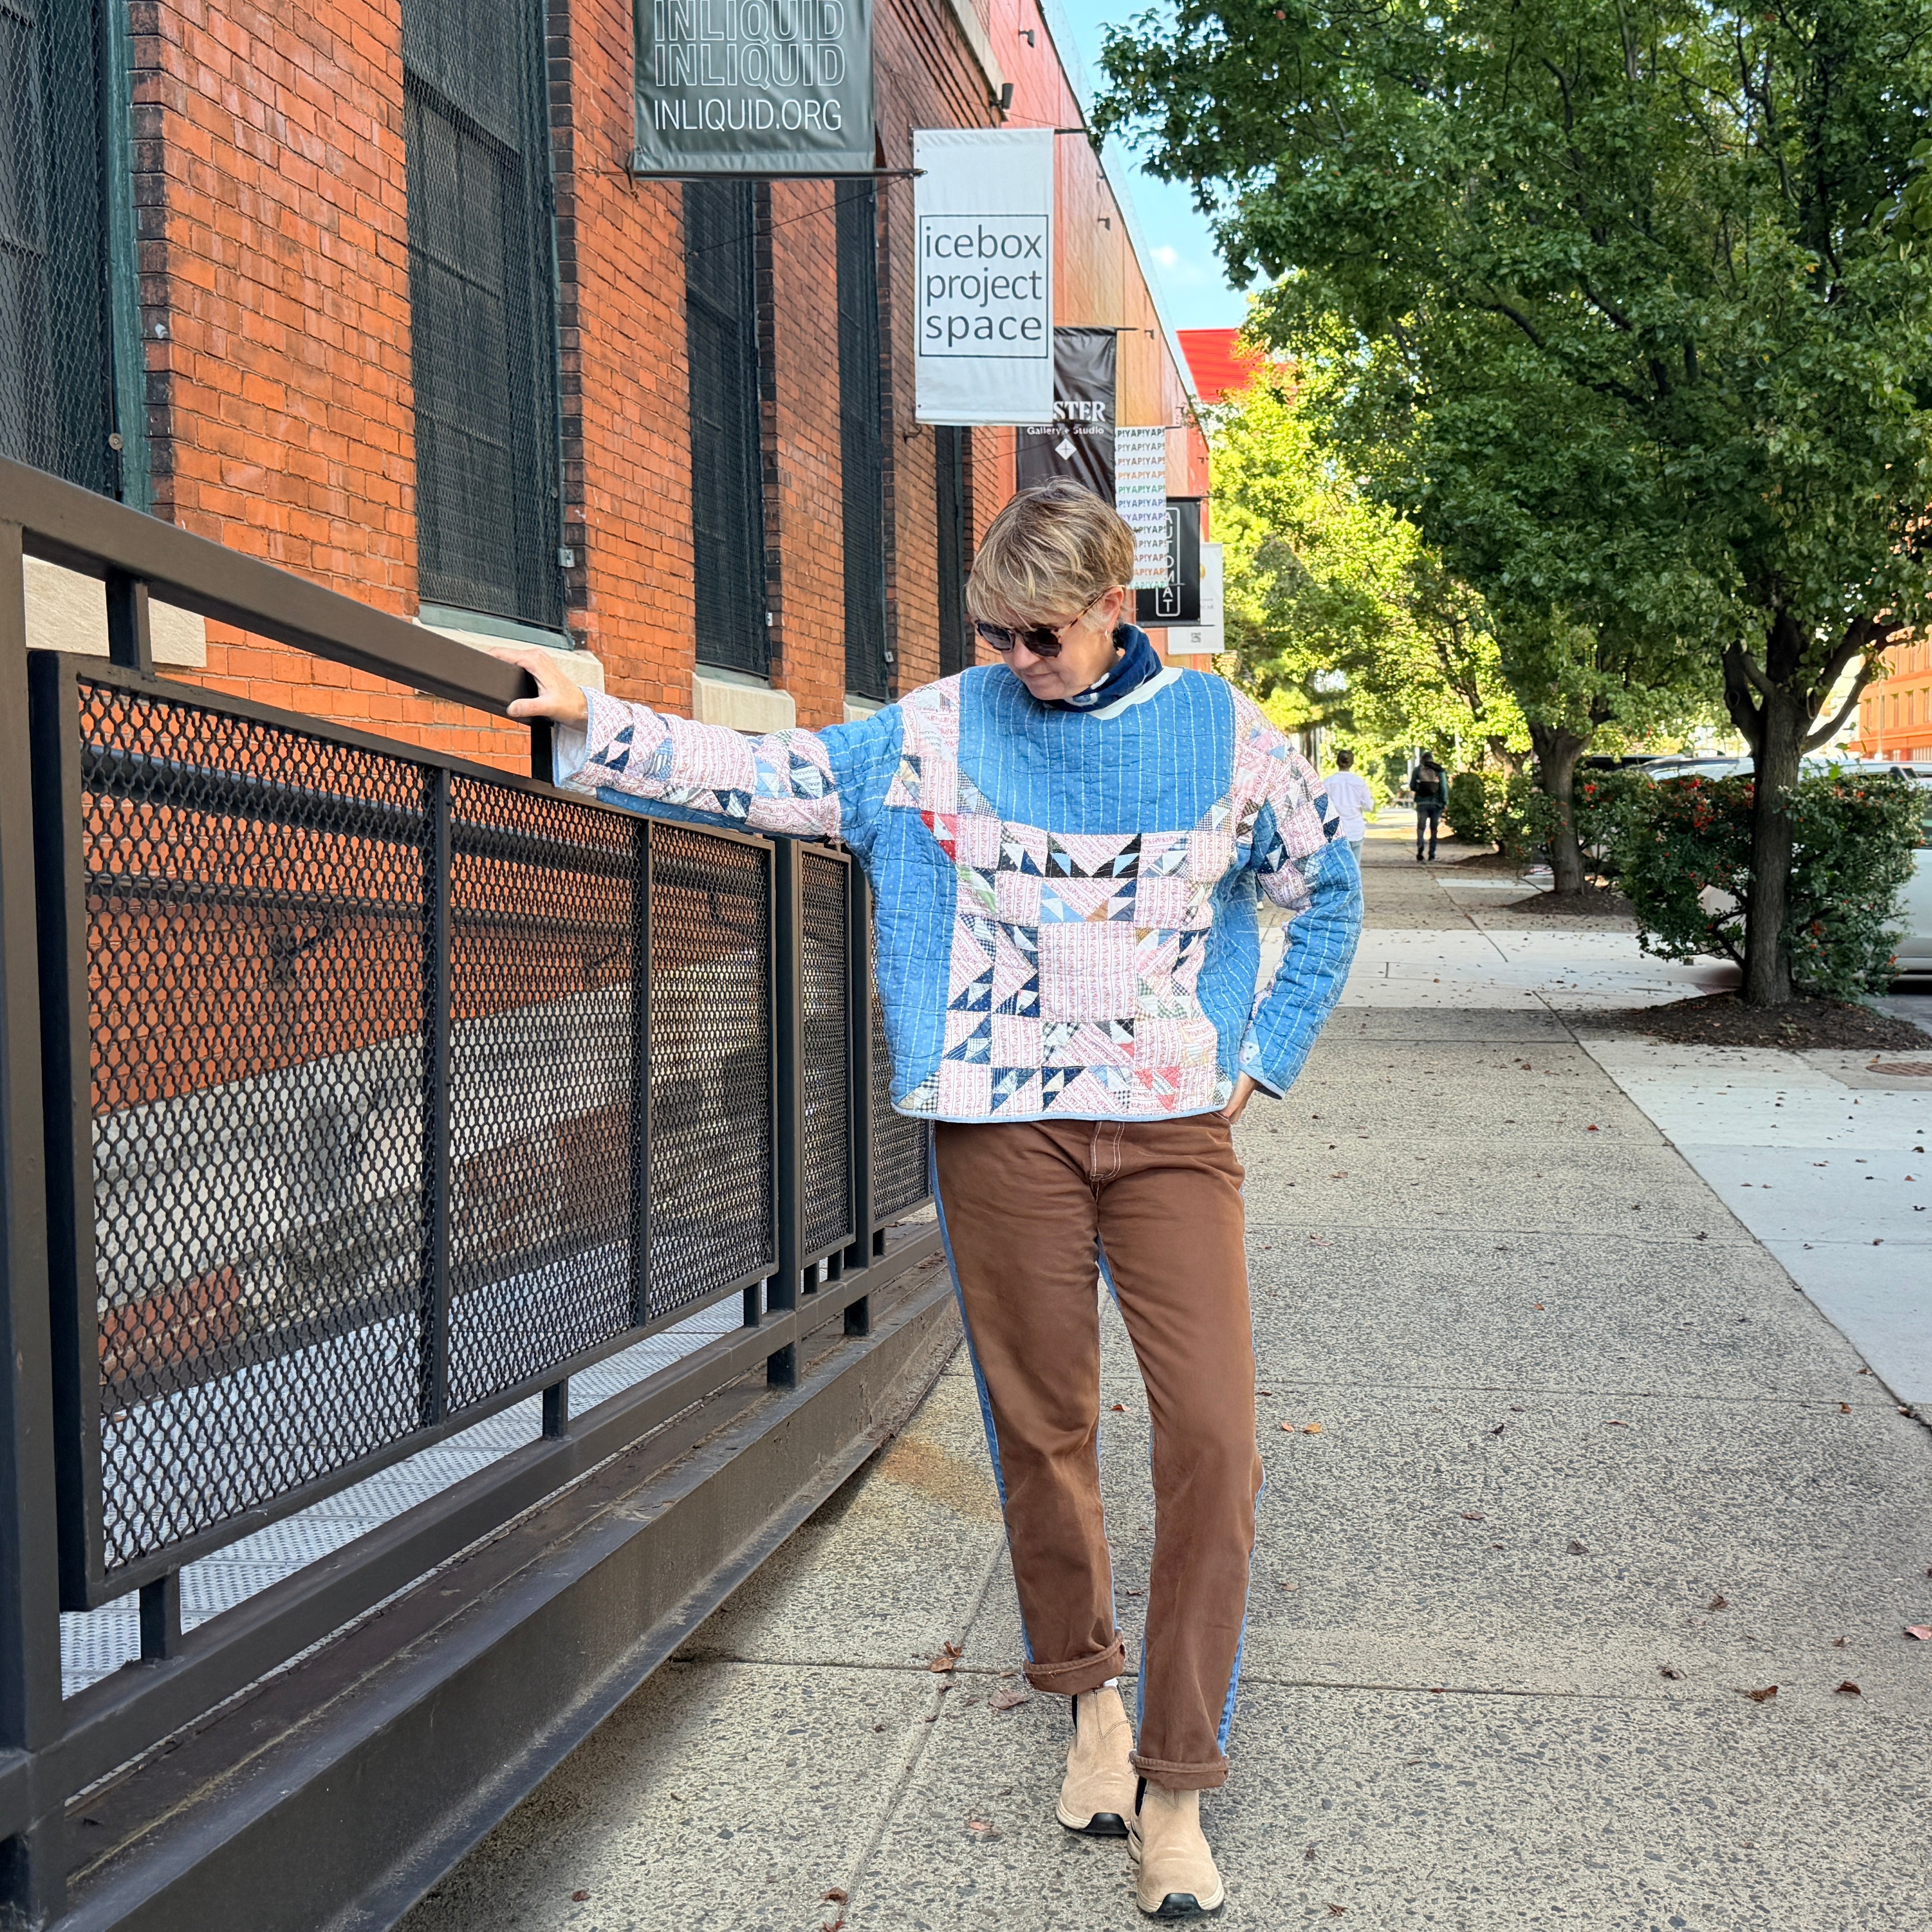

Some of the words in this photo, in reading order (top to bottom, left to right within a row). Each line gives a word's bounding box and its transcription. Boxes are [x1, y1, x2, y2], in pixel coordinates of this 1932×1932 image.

[654, 0, 845, 44] INLIQUID
[655, 43, 846, 90] INLIQUID
[654, 99, 842, 131] INLIQUID.ORG
[925, 224, 1042, 258] icebox
[927, 267, 1042, 307] project
[925, 314, 1042, 347] space
[1026, 427, 1060, 435] Gallery
[1073, 426, 1104, 434] Studio
